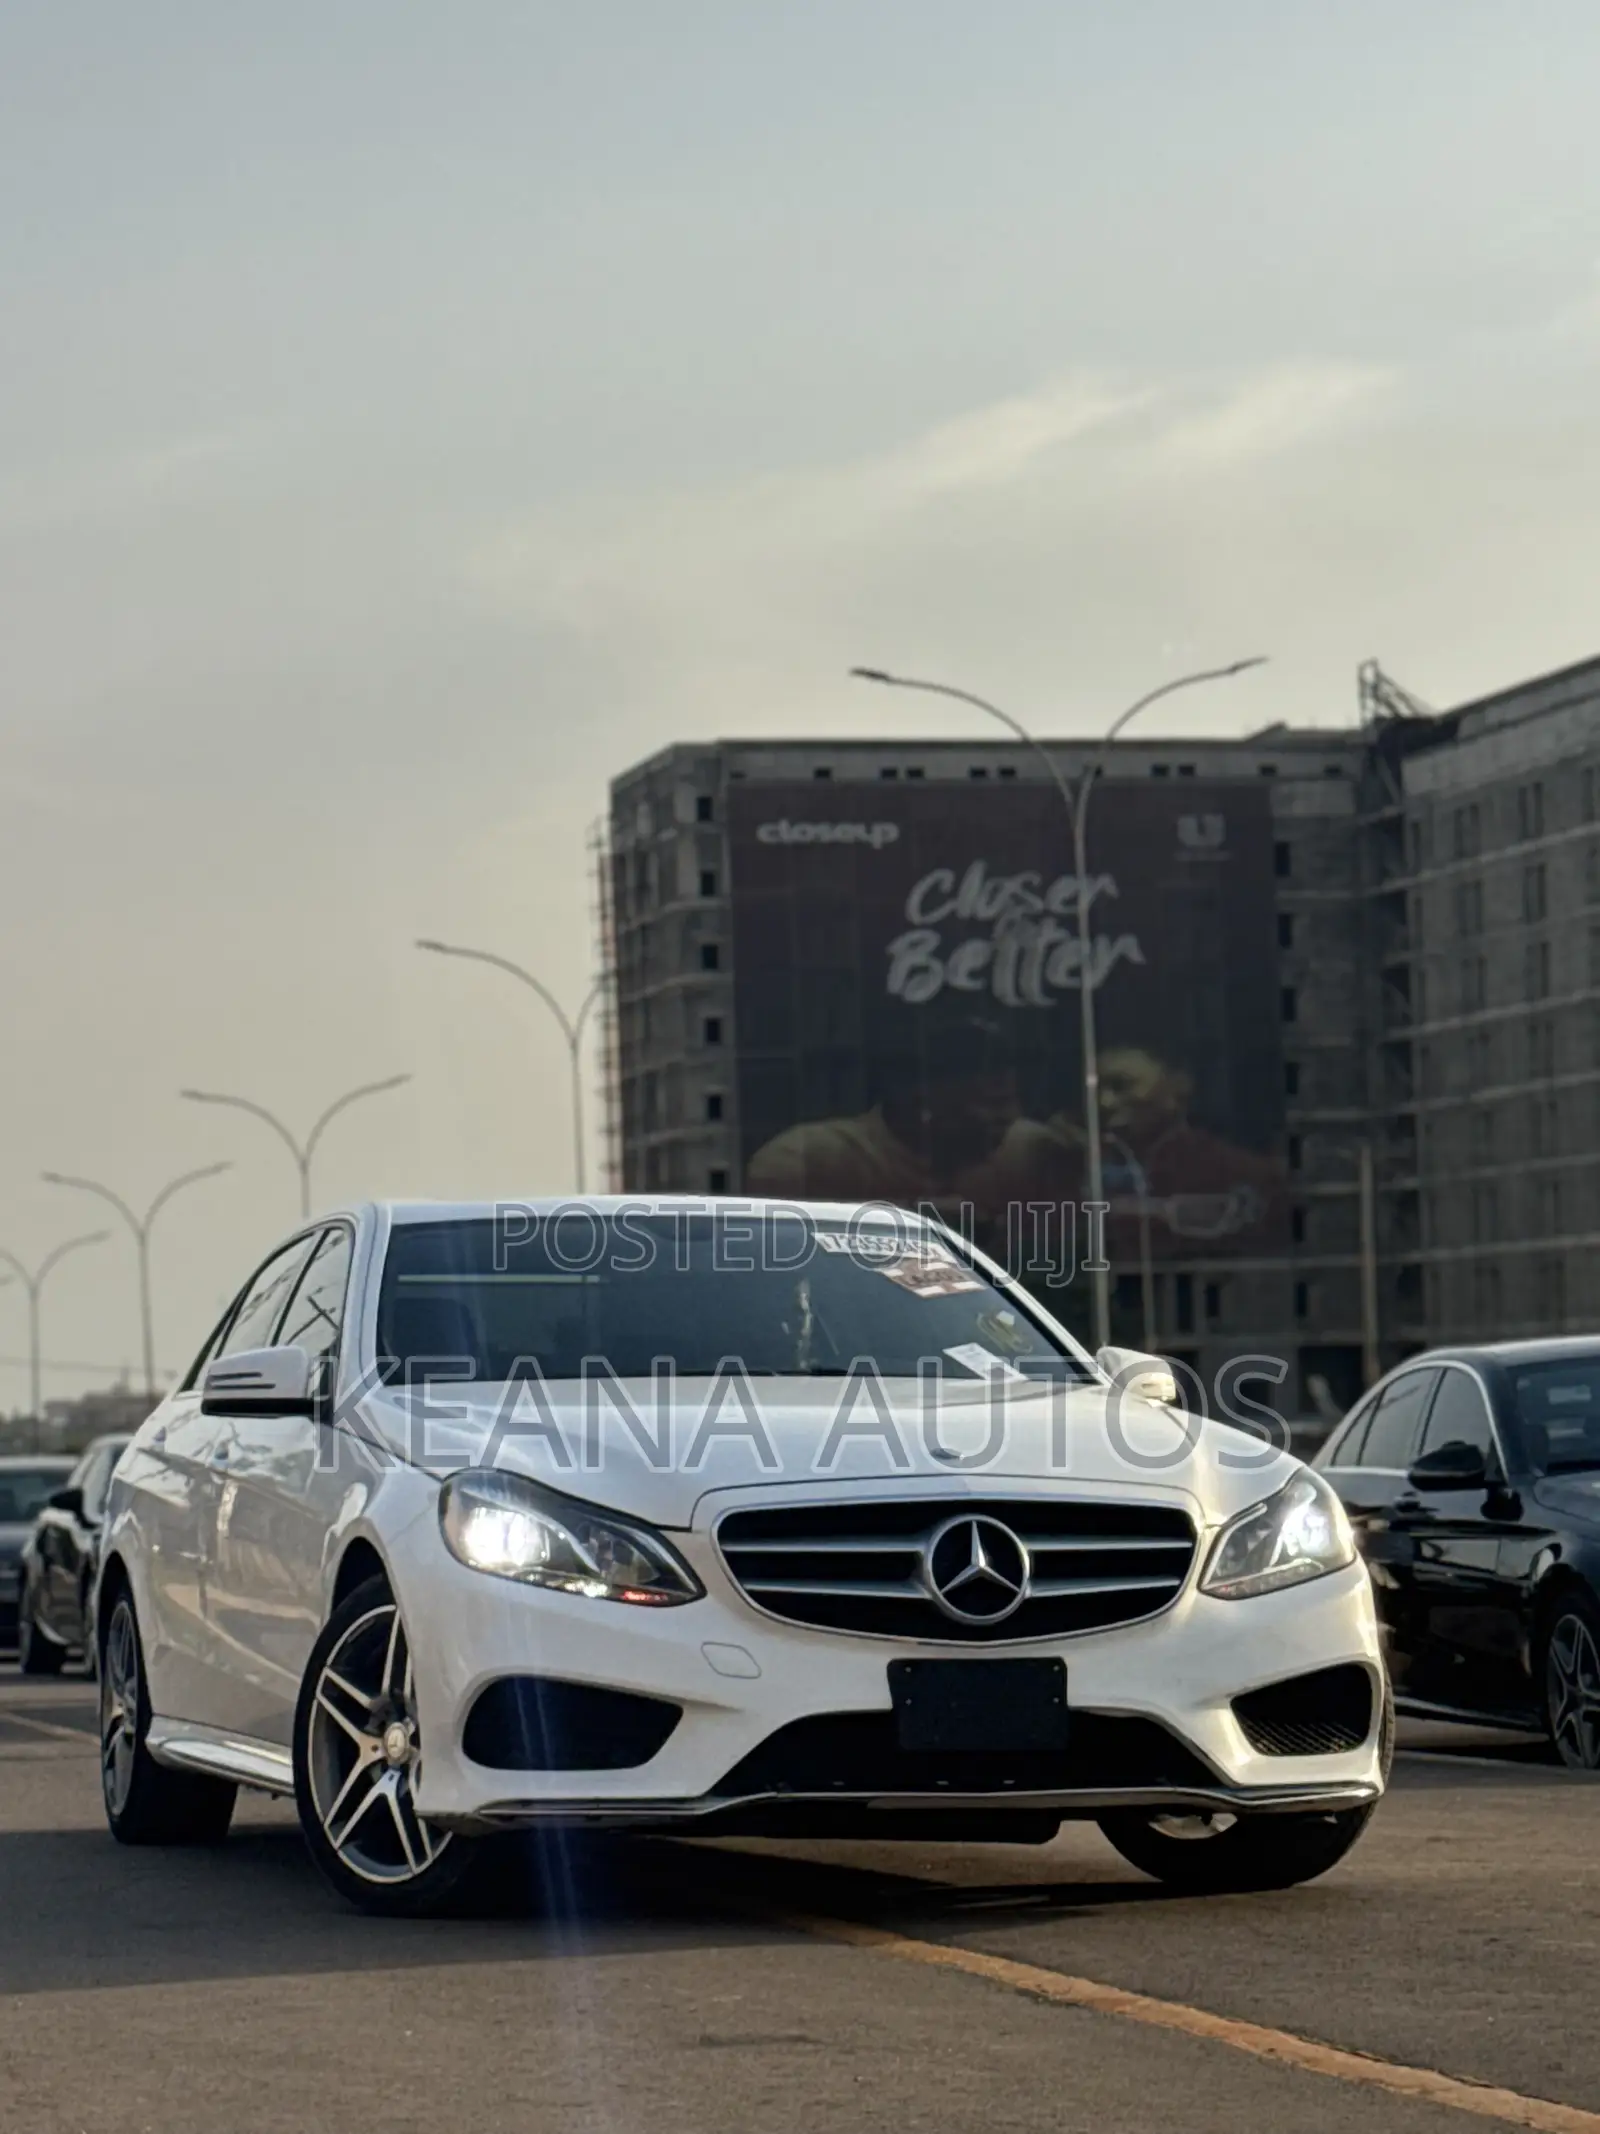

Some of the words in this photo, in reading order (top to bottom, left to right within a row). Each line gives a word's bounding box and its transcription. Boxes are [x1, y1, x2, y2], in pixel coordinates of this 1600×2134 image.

[755, 817, 901, 850] closeup
[904, 858, 1120, 926] Closer
[885, 914, 1146, 1007] Better
